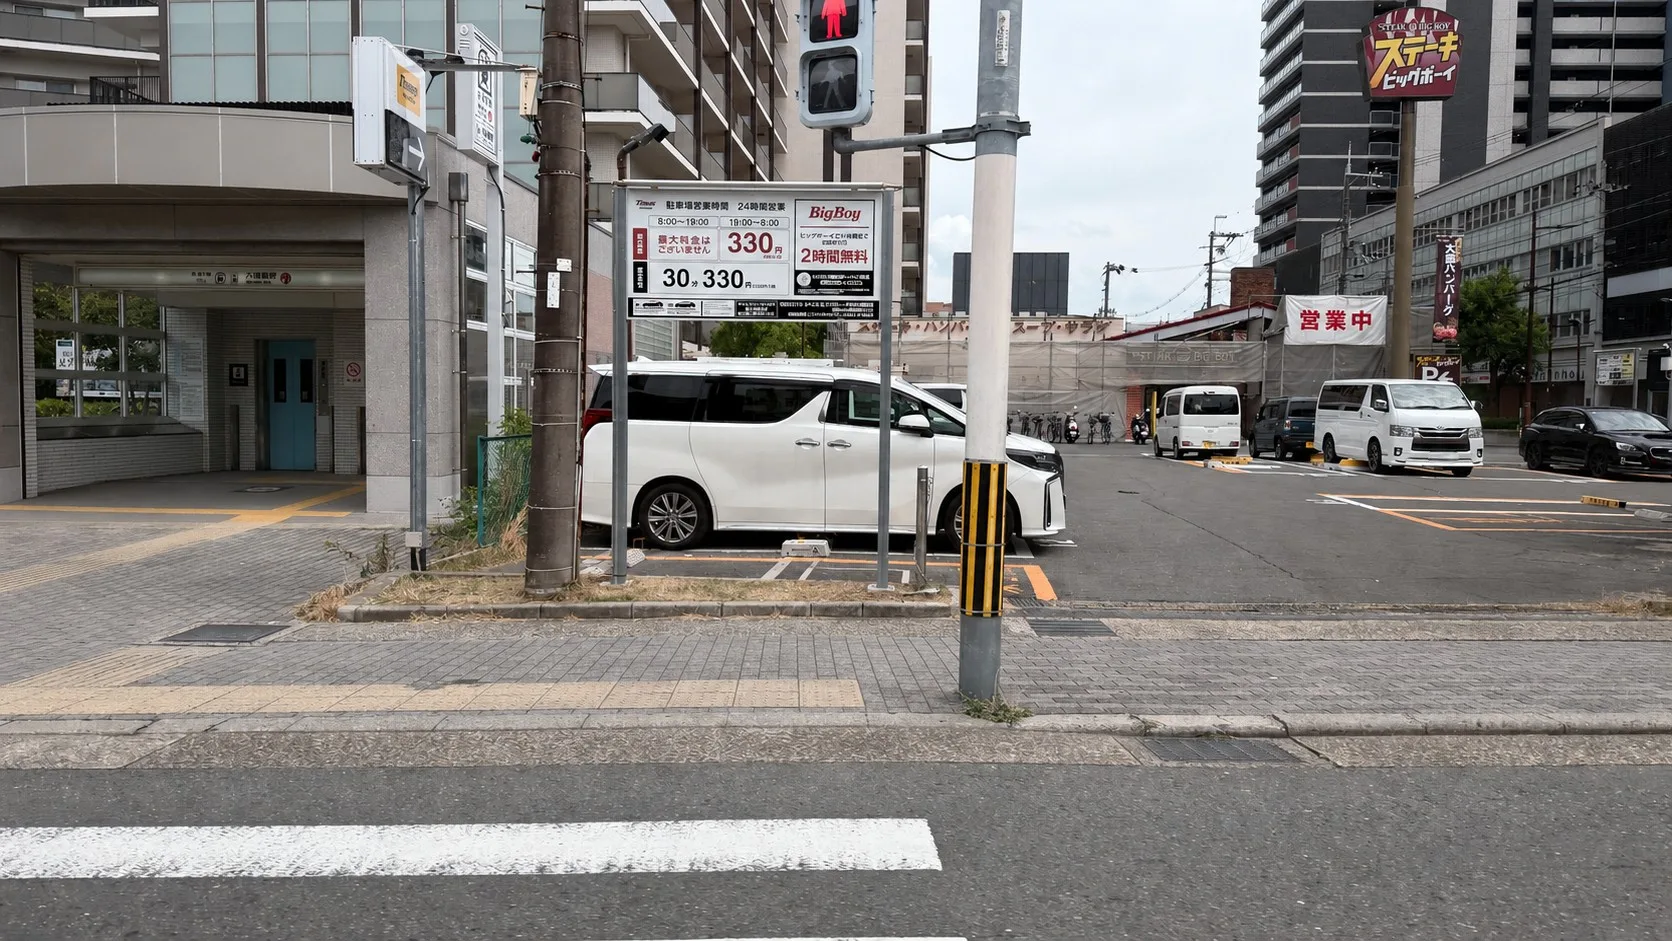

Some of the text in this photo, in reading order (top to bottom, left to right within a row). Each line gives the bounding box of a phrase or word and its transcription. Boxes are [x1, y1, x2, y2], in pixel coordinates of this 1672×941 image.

[1370, 31, 1459, 89] ステーキ
[1382, 65, 1456, 90] ビッグボーイ
[666, 201, 786, 212] 駐車場営業時間 24時間営業
[809, 206, 861, 222] BigBoy
[658, 234, 711, 245] 最大料金は
[658, 245, 711, 254] ございません
[801, 248, 868, 264] 2時間無料
[1300, 309, 1372, 331] 営業中
[1422, 366, 1439, 381] P
